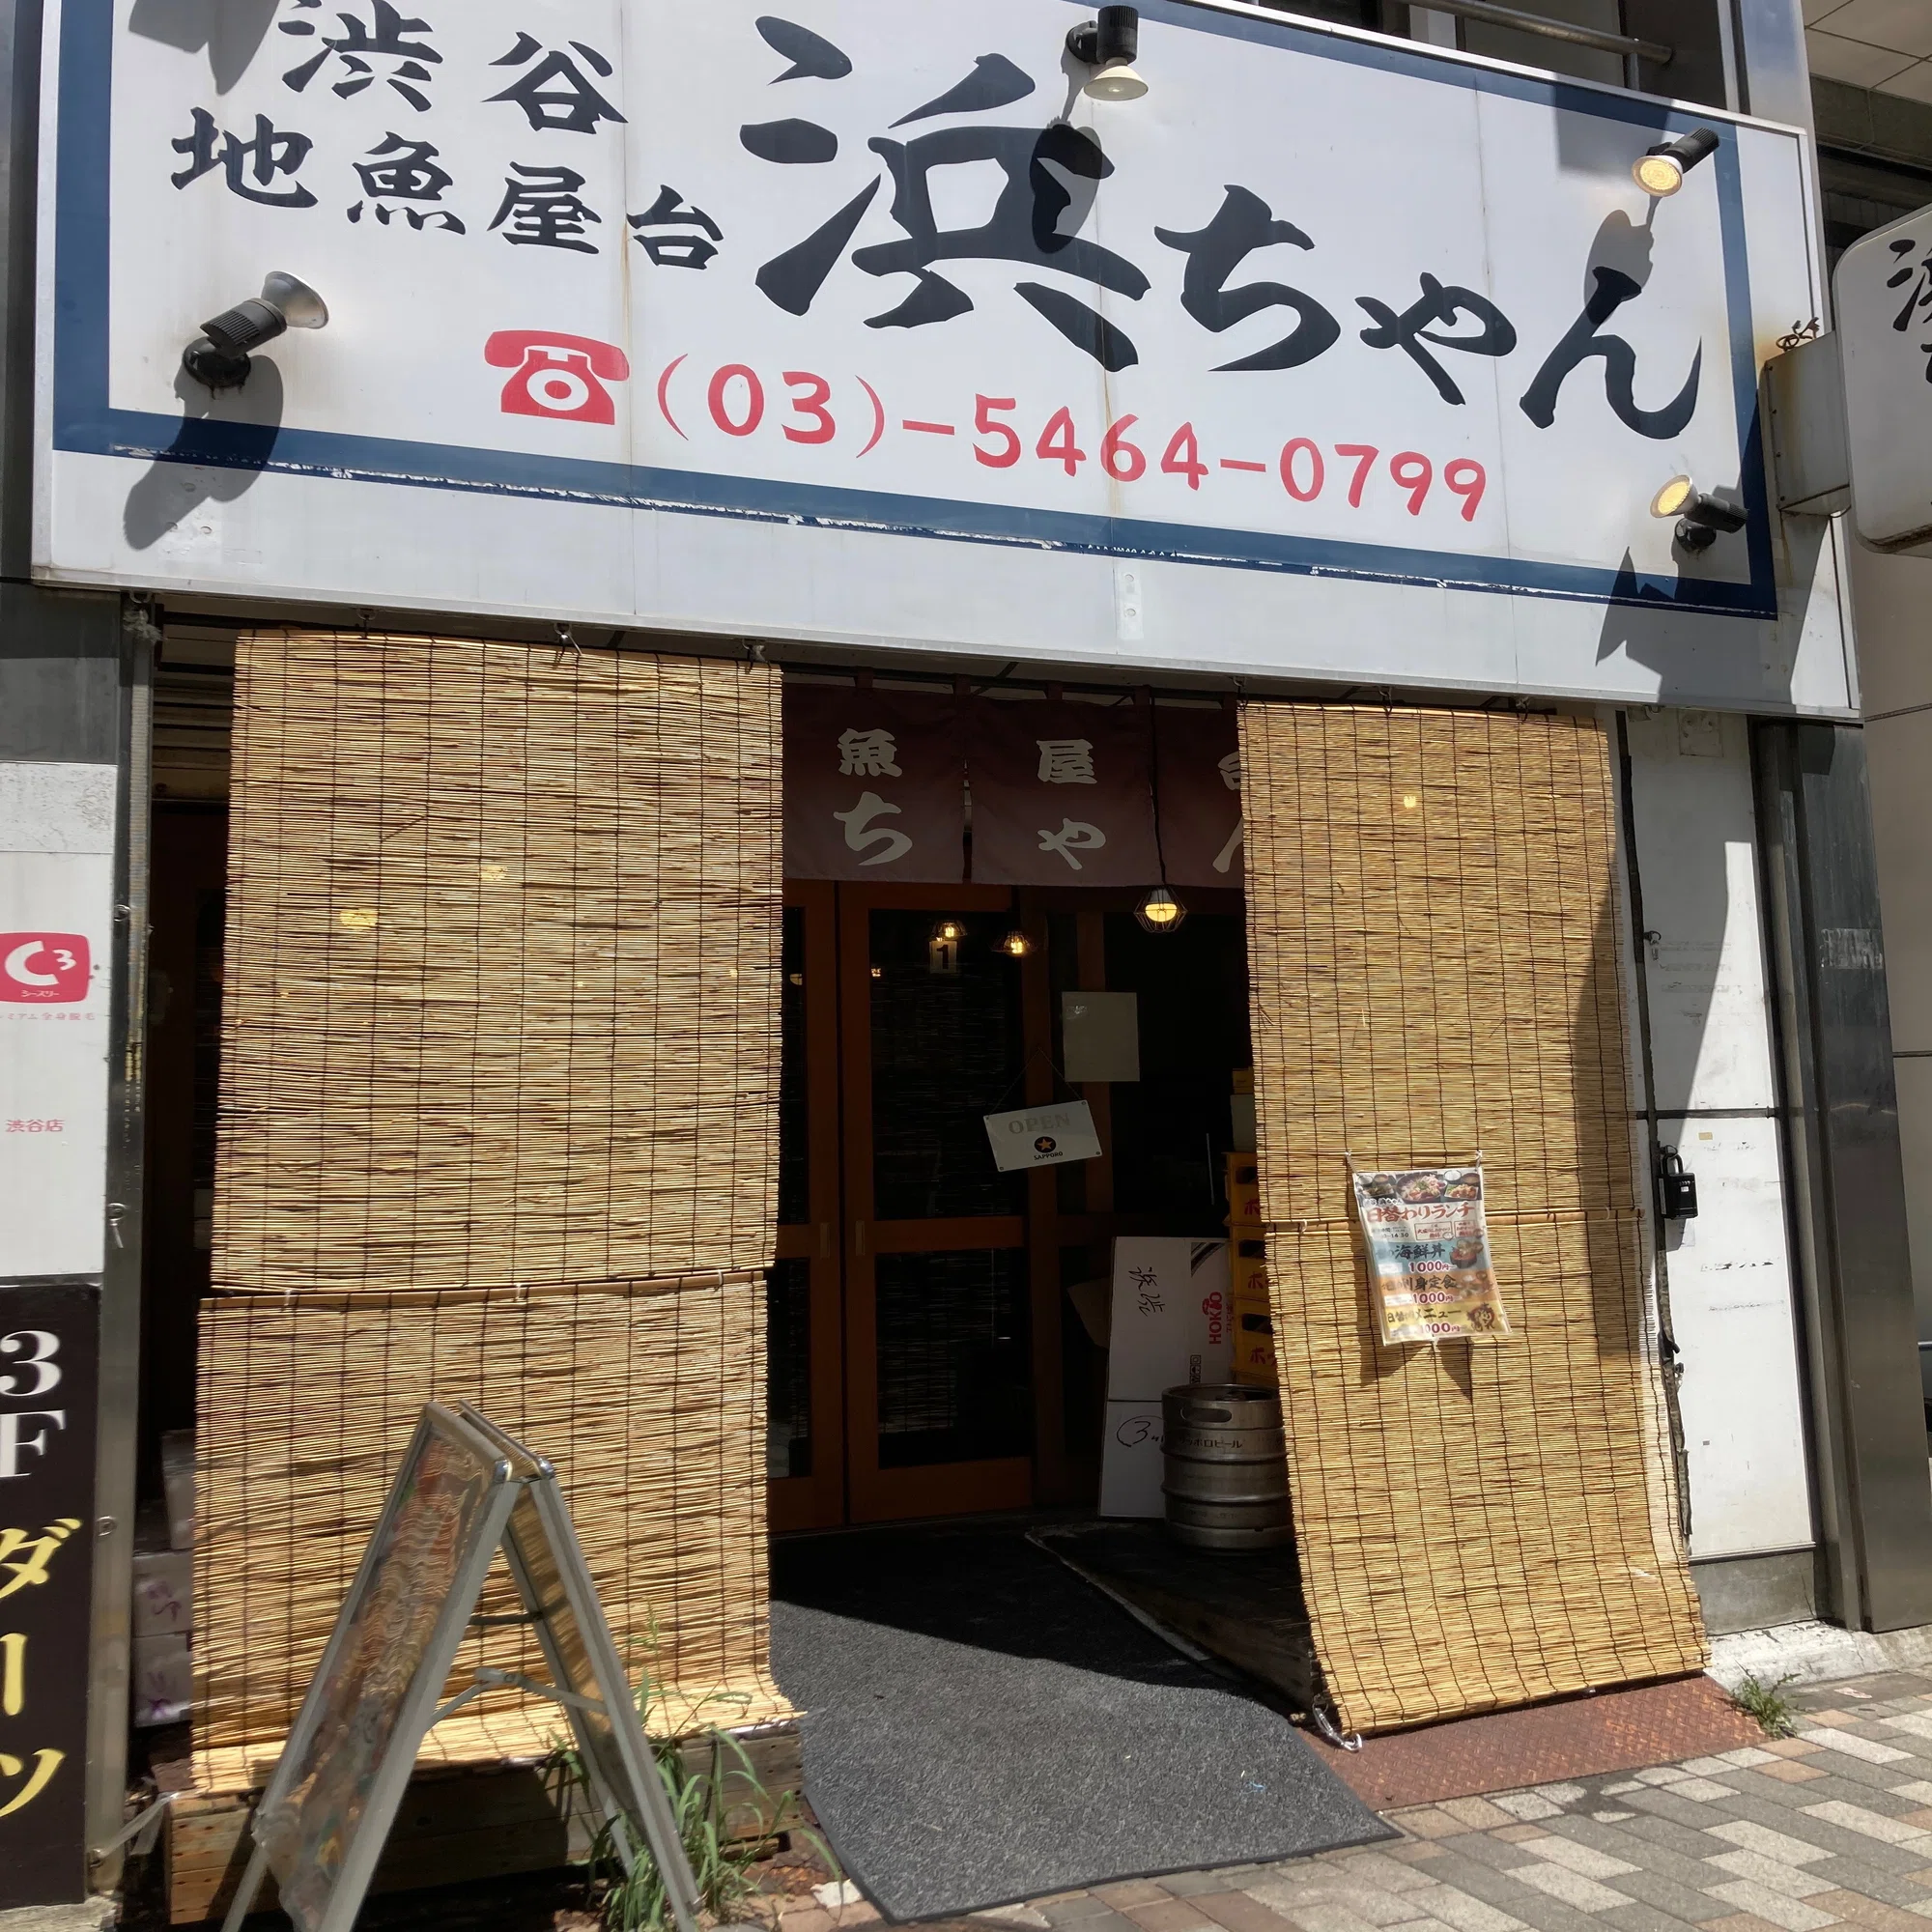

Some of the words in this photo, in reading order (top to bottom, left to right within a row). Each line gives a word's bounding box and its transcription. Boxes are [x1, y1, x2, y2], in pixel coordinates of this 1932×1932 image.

[277, 0, 628, 134] 渋谷
[170, 106, 724, 270] 地魚屋台
[739, 15, 1703, 440] 浜ちゃん
[20, 989, 61, 998] シースリー
[0, 1011, 96, 1021] ミアム全身脱毛
[5, 1119, 66, 1133] 渋谷店
[1008, 1112, 1071, 1135] OPEN
[1034, 1151, 1064, 1161] SAPPORO
[1367, 1201, 1475, 1223] 日替わりランチ
[1179, 1435, 1243, 1449] サッポロビール
